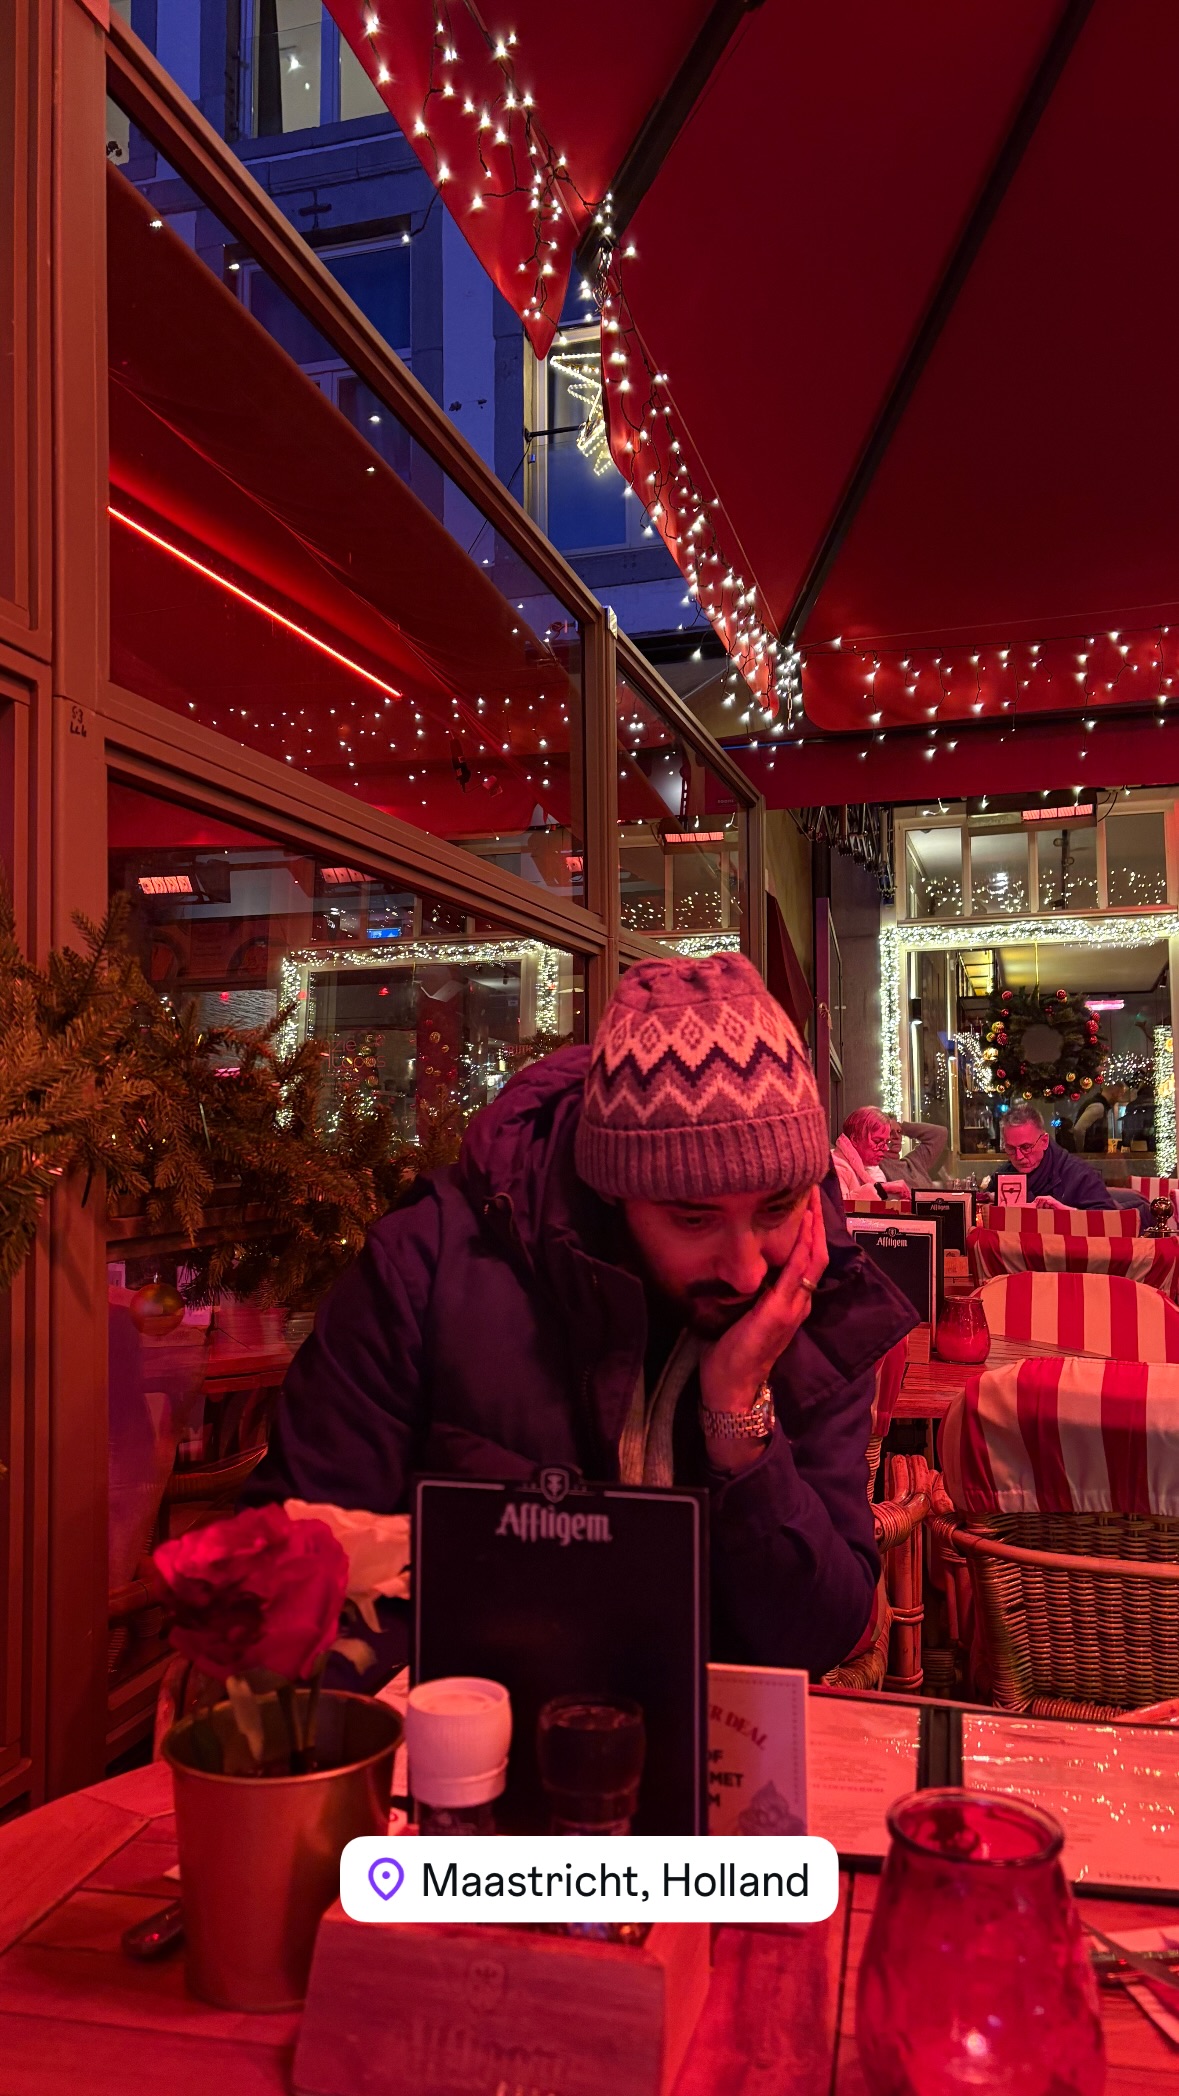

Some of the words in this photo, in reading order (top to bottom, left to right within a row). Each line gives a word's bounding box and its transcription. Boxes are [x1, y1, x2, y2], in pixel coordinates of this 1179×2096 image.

[876, 1237, 907, 1249] Affligem
[496, 1502, 613, 1546] Affligem
[709, 1705, 723, 1721] R
[725, 1711, 767, 1751] DEAL
[709, 1772, 743, 1787] MET
